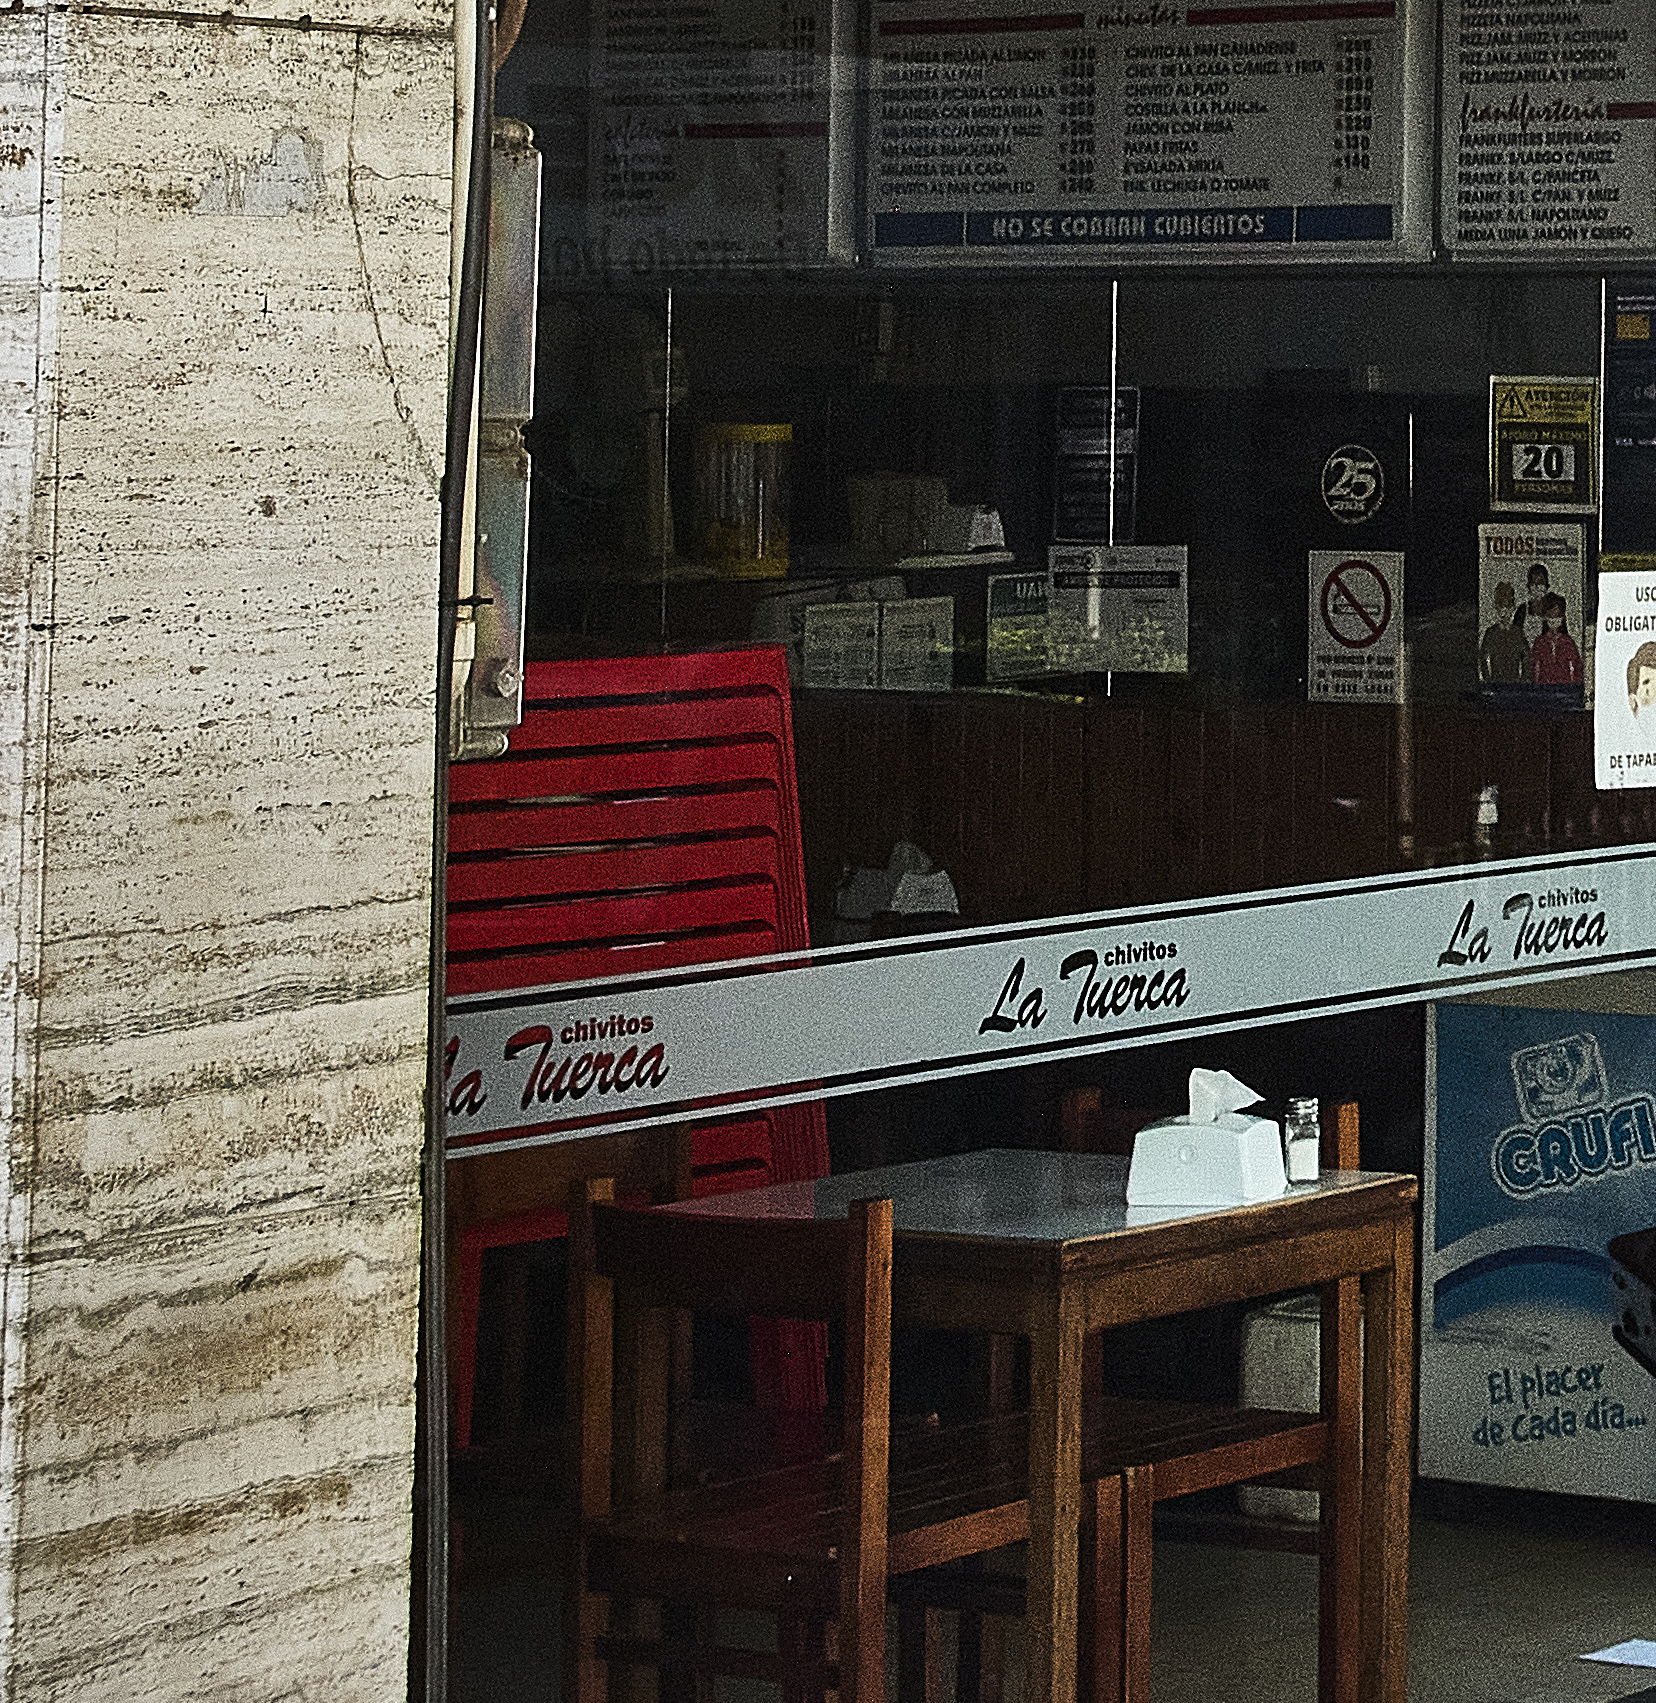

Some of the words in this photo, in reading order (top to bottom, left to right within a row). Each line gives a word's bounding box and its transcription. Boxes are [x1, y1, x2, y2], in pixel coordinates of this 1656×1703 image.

[992, 217, 1024, 238] NO
[1031, 216, 1053, 237] SE
[1060, 215, 1146, 237] COBRAN
[1154, 213, 1266, 236] CUBIERTOS
[1327, 457, 1377, 500] 25
[1522, 446, 1564, 479] 20
[1484, 535, 1534, 555] TODOS
[1609, 755, 1624, 769] DE
[1537, 887, 1599, 910] chivitos
[1437, 898, 1492, 967] La
[1503, 893, 1608, 959] Tuerca
[1103, 940, 1178, 969] chivitos
[978, 956, 1048, 1035] La
[1060, 949, 1191, 1025] Tuerca
[560, 1012, 655, 1046] chivitos
[504, 1022, 671, 1112] Tuerca
[1488, 1368, 1512, 1407] El
[1519, 1361, 1605, 1408] placer
[1473, 1413, 1505, 1448] de
